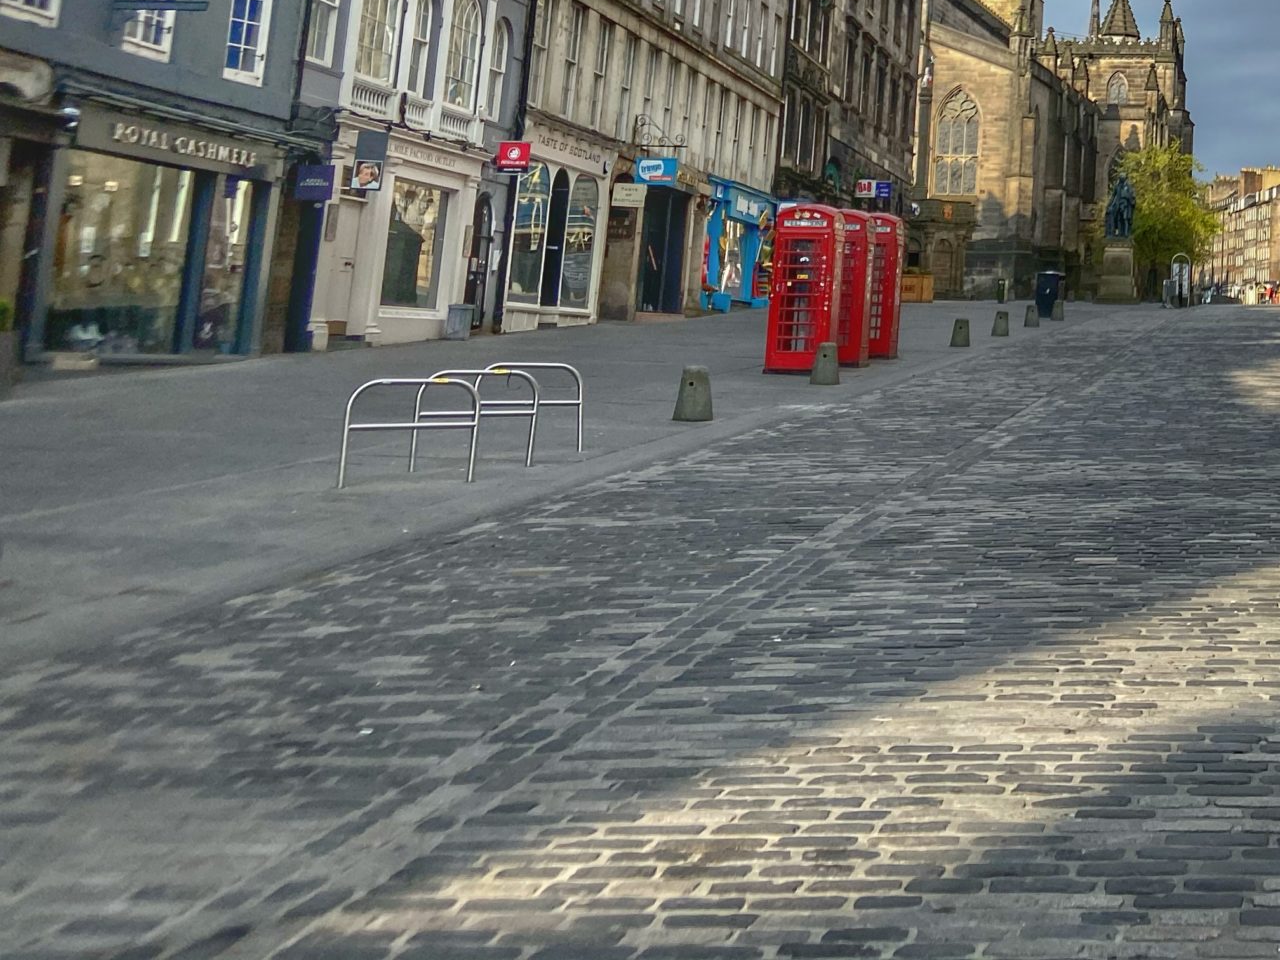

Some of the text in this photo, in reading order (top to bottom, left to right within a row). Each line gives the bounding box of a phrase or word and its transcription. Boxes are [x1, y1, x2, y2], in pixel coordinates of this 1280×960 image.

[112, 123, 257, 168] ROYAL CASHMERE
[538, 134, 601, 164] TASTE OF SCOTLAND
